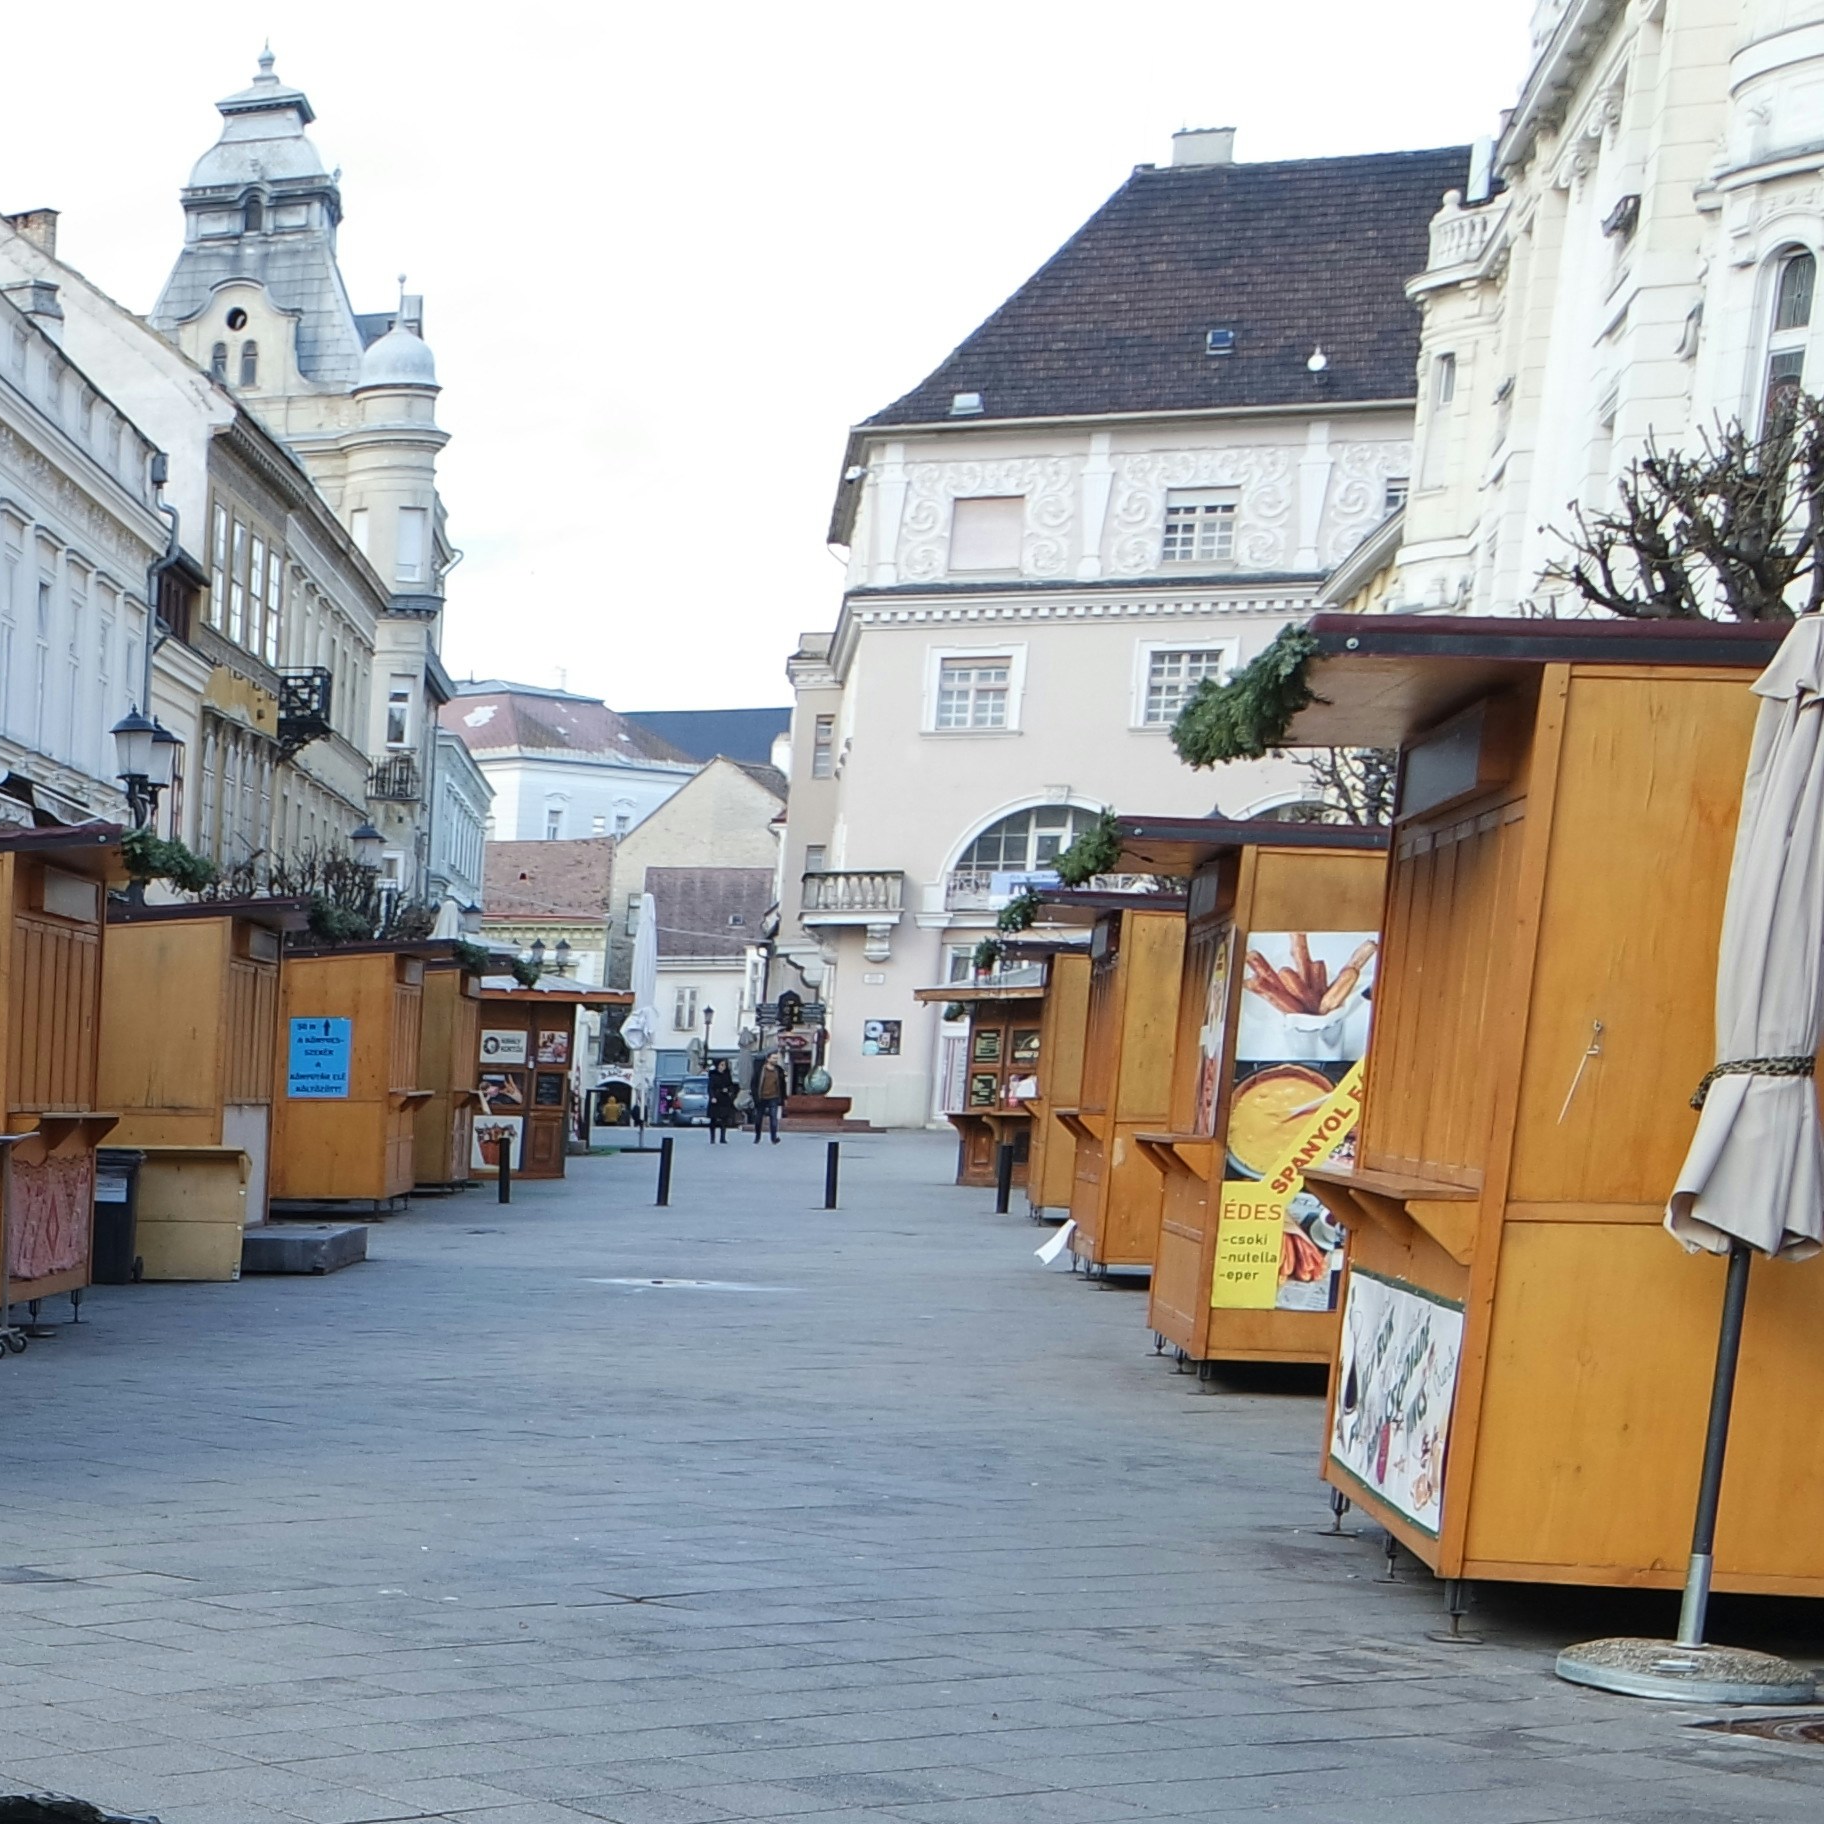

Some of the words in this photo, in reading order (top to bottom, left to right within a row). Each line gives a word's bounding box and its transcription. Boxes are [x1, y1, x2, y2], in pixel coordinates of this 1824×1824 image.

[1270, 1105, 1354, 1195] SPANYOL
[1223, 1199, 1283, 1221] ÉDES
[1222, 1231, 1268, 1246] -csoki
[1220, 1252, 1278, 1264] -nutella
[1219, 1269, 1260, 1282] -eper
